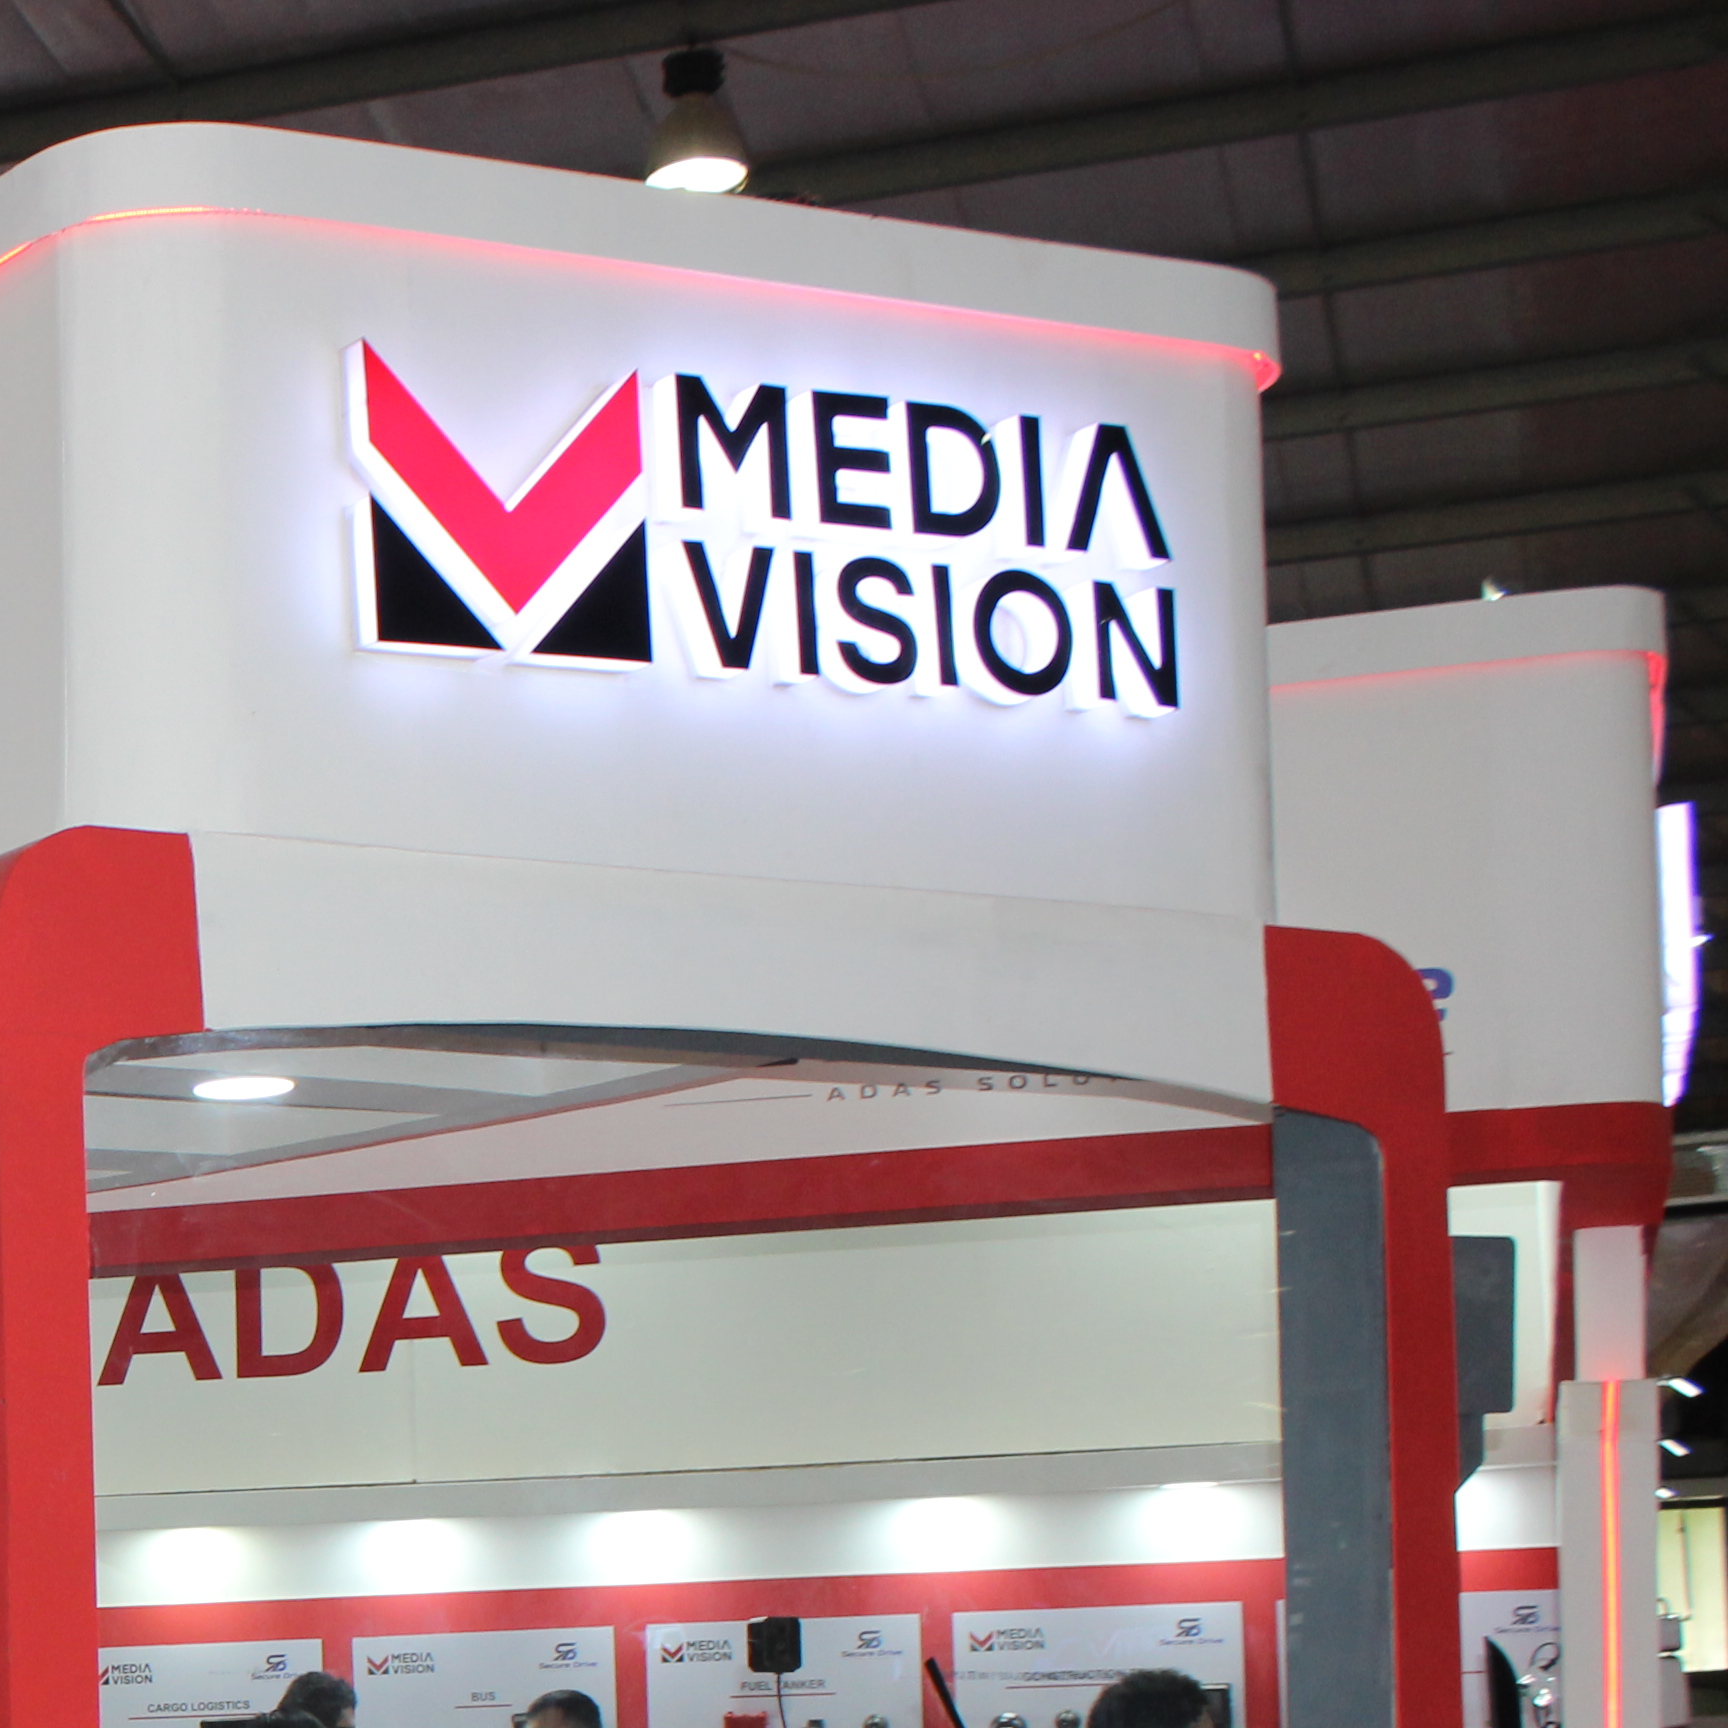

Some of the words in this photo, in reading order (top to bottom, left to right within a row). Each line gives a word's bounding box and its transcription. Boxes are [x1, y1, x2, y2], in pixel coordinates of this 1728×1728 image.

[672, 372, 1173, 561] MEDIA
[680, 539, 1180, 708] VISION
[826, 1079, 943, 1102] ADAS
[976, 1074, 1117, 1091] SOLU
[97, 1246, 606, 1386] ADAS
[995, 1628, 1044, 1640] MEDIA
[686, 1640, 733, 1651] MEDIA
[995, 1639, 1044, 1650] VISION
[391, 1652, 434, 1664] MEDIA
[686, 1651, 733, 1662] VISION
[111, 1663, 152, 1675] MEDIA
[391, 1664, 435, 1675] VISION
[112, 1674, 153, 1686] VISION
[741, 1680, 772, 1691] FUEL
[471, 1691, 496, 1702] BUS
[147, 1702, 189, 1714] CARGO
[191, 1700, 250, 1712] LOGISTICS
